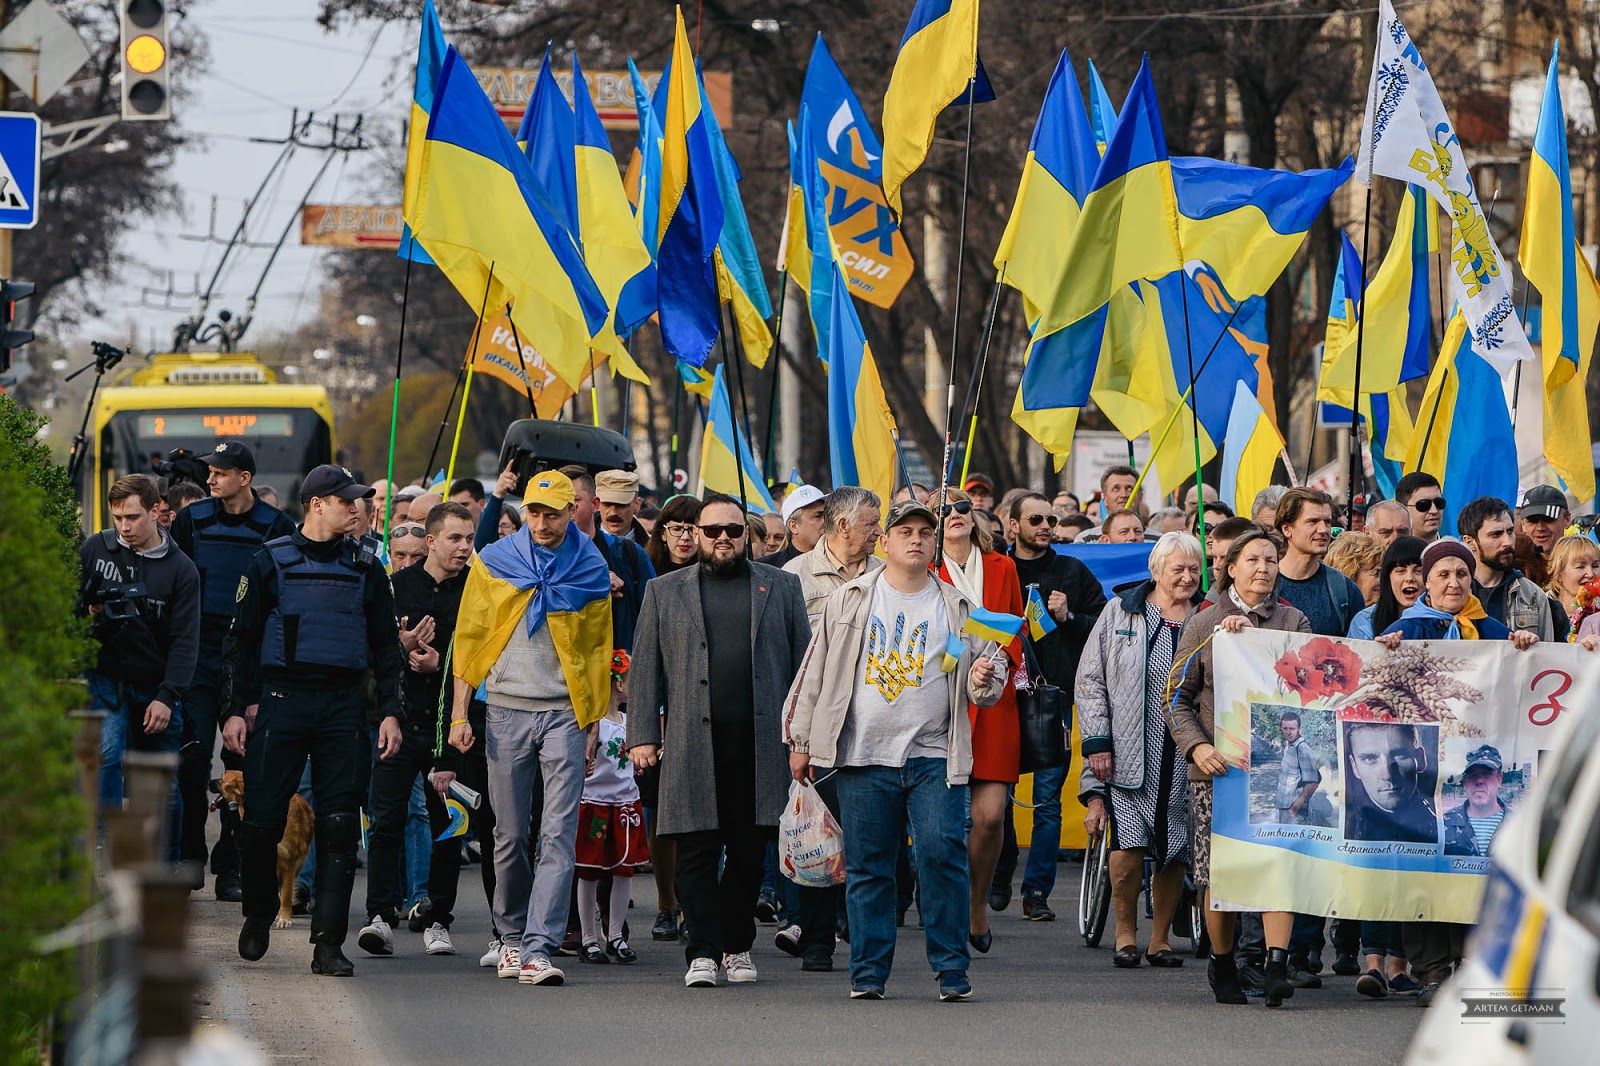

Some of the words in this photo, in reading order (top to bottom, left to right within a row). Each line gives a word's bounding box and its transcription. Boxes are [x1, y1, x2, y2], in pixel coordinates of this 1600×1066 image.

[314, 206, 404, 235] ДЕЛЮ
[841, 251, 891, 280] СИЛ
[154, 417, 165, 436] 2
[1251, 827, 1306, 839] Литвинов
[1394, 844, 1439, 857] Дмитро
[1452, 858, 1486, 871] Білий
